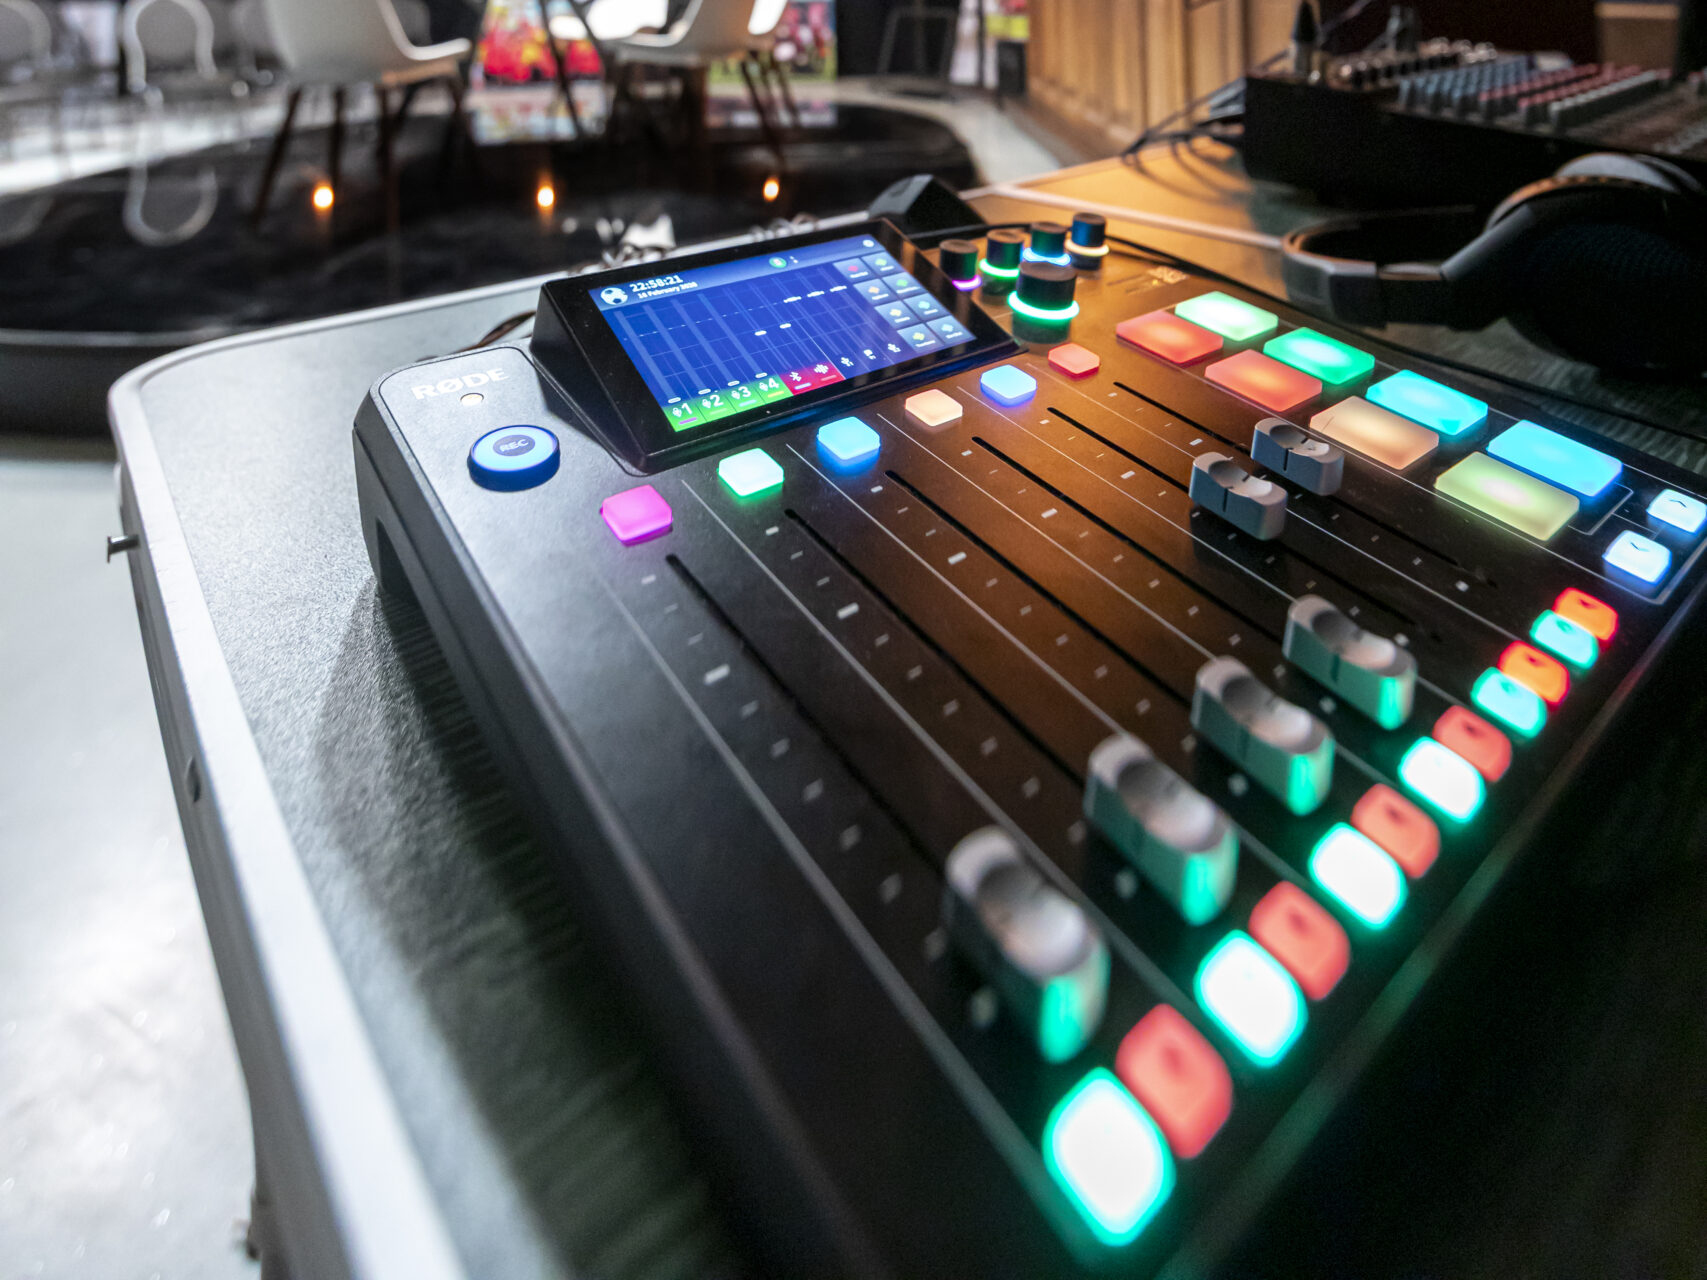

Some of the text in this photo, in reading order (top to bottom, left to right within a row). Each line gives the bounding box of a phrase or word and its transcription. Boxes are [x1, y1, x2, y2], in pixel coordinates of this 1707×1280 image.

[629, 275, 684, 293] 22:58:21
[411, 367, 510, 400] RØDE
[767, 377, 780, 389] 4
[737, 385, 751, 398] 3
[709, 394, 724, 407] 2
[681, 402, 693, 415] 1
[499, 438, 529, 452] REC
